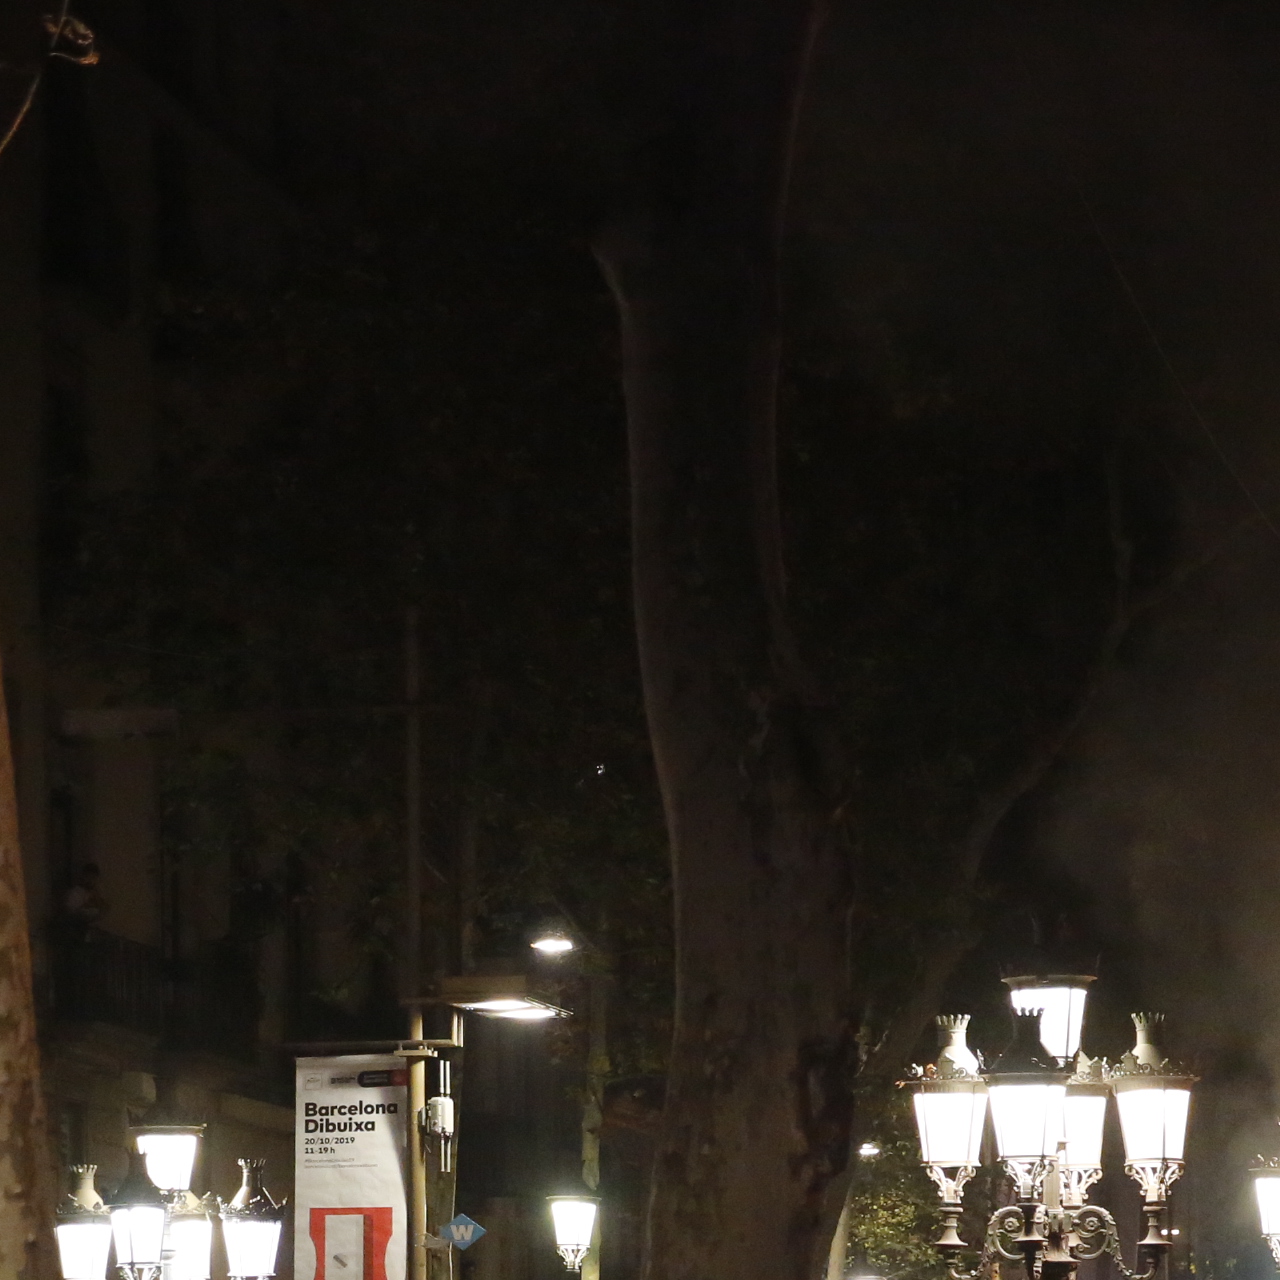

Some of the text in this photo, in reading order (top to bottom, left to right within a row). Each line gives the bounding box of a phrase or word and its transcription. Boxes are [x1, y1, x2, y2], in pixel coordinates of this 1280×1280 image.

[305, 1100, 398, 1117] Barcelona
[305, 1117, 375, 1134] Dibuixa
[305, 1137, 355, 1145] 20/10/2019
[450, 1225, 474, 1240] W
